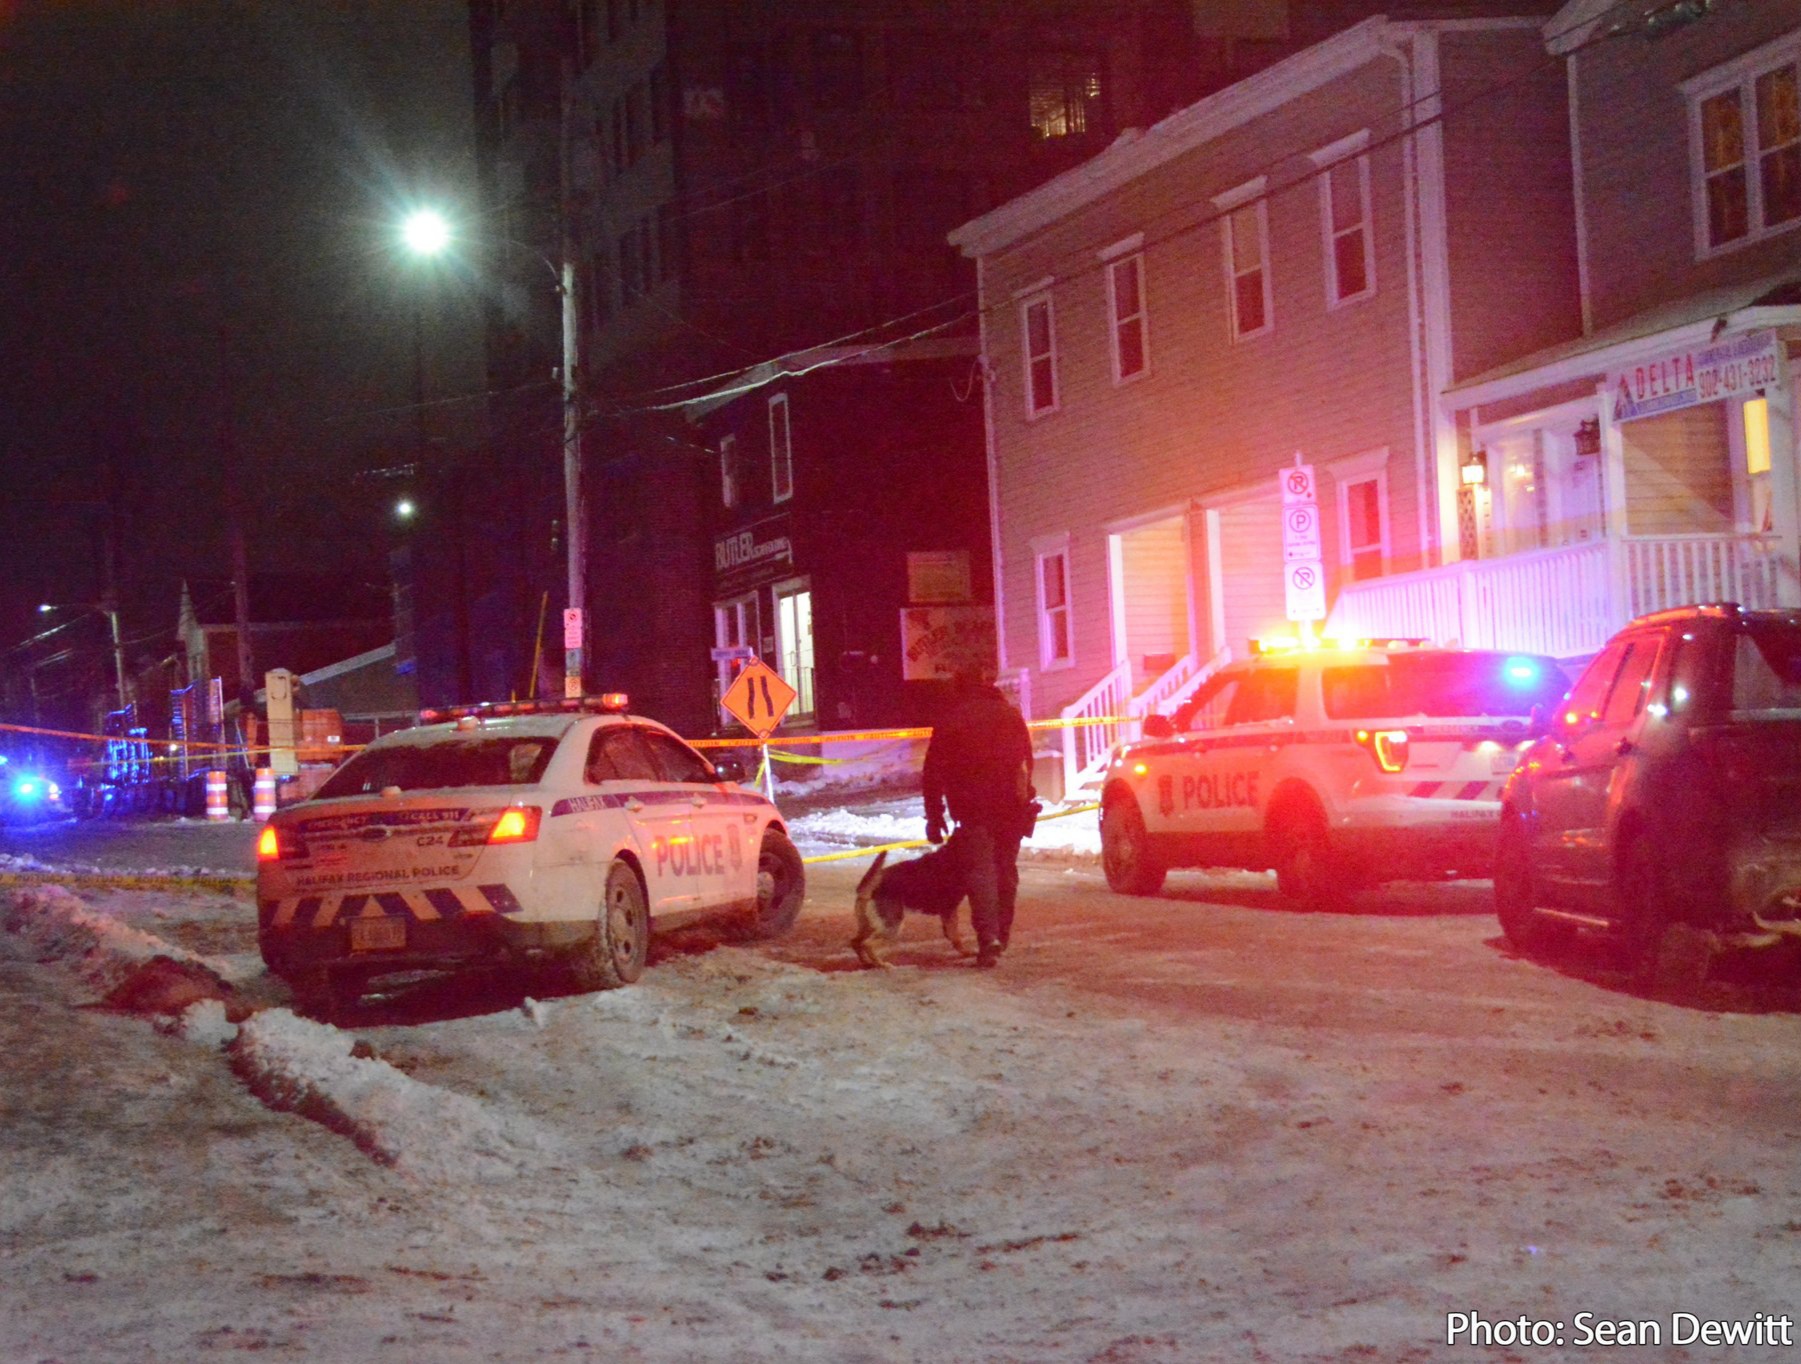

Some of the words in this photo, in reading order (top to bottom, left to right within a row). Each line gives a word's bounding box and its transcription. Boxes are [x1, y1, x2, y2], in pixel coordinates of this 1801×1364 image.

[1635, 352, 1695, 399] DELTA
[715, 532, 753, 571] BUTLER
[1182, 770, 1260, 810] POLICE
[416, 834, 444, 847] C24
[655, 833, 726, 879] POLICE
[296, 872, 344, 887] HALIFAX
[346, 868, 410, 883] REGIONAL
[412, 864, 460, 880] POLICE
